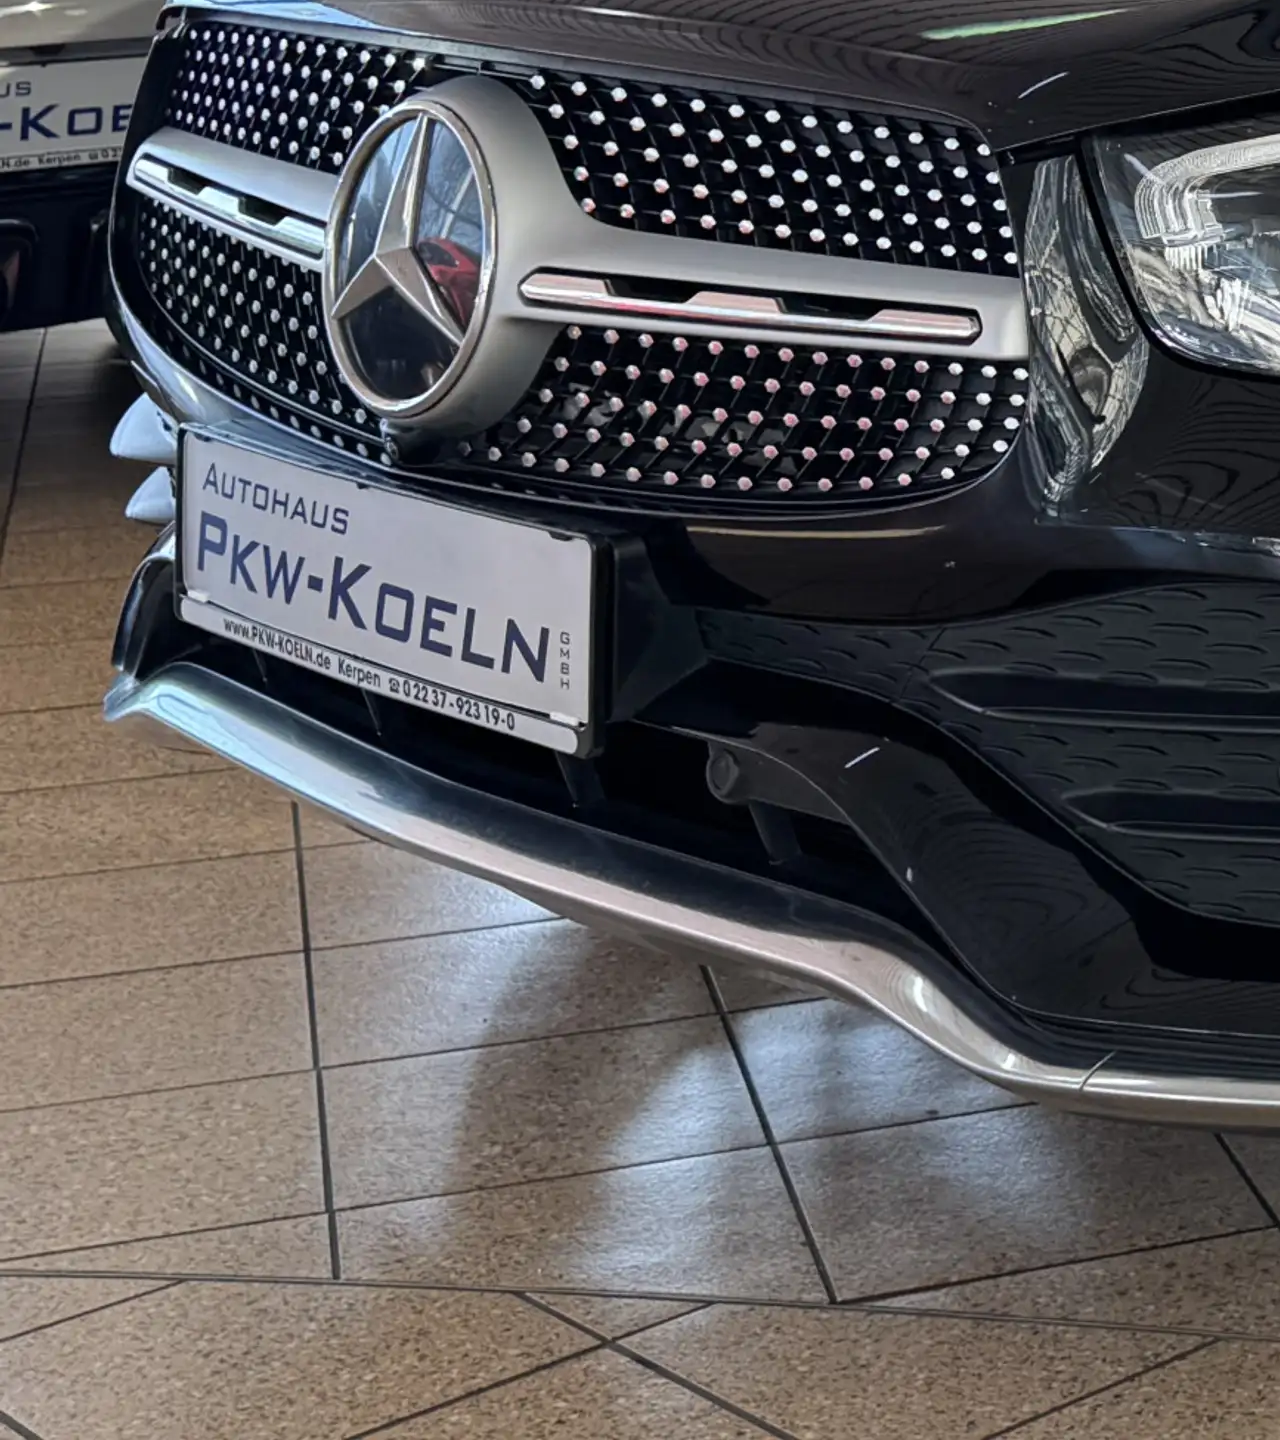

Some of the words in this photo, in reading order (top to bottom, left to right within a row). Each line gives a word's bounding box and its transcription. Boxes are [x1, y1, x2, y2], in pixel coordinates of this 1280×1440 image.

[38, 154, 81, 166] Kerpen
[202, 462, 349, 536] AUTOHAUS
[197, 510, 550, 684] PKW-KOELN
[223, 618, 332, 670] www.PKW-KOELN.de
[337, 656, 382, 689] Kerpen
